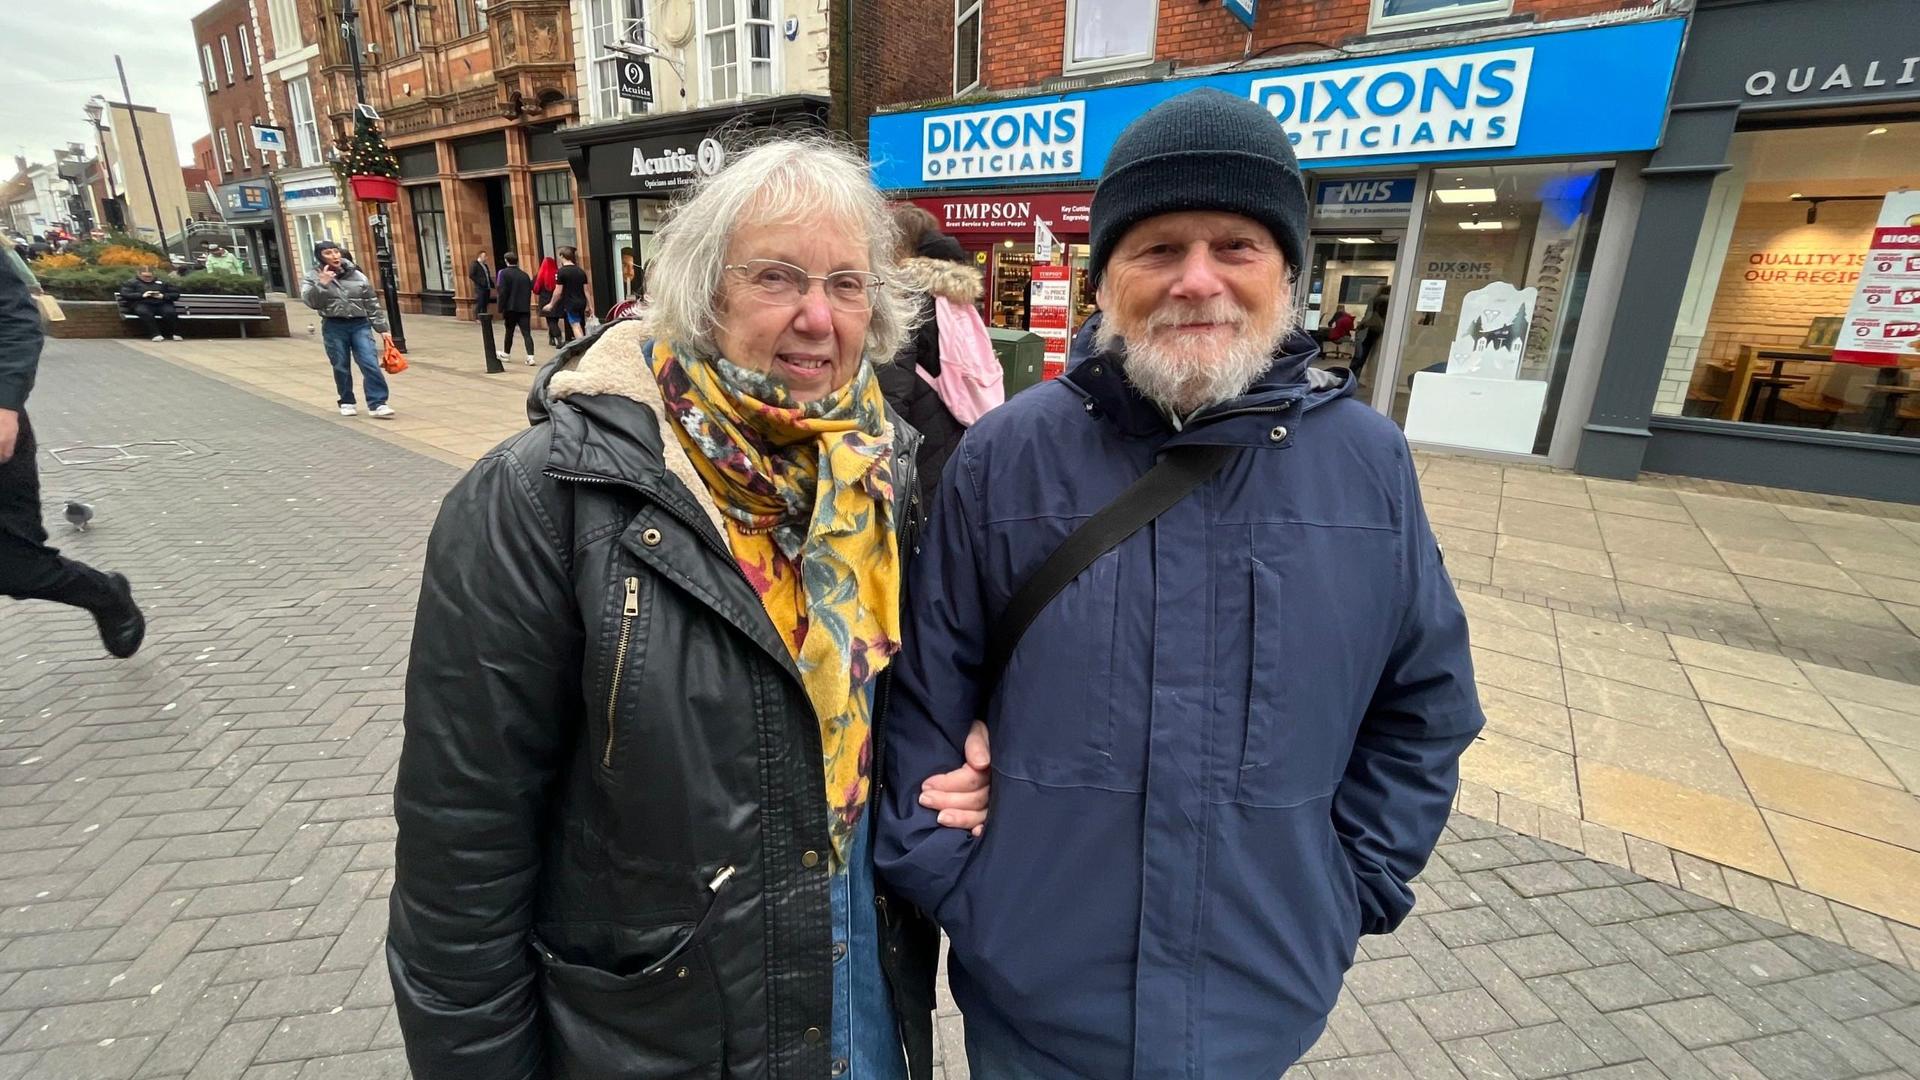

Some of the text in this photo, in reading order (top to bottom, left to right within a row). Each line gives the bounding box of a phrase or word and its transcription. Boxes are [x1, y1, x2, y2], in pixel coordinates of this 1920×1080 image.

[1745, 57, 1920, 96] QUALI
[622, 84, 651, 96] Acuitis
[1259, 59, 1516, 124] DIXONS
[928, 108, 1076, 154] DIXONS
[1287, 116, 1506, 151] PTICIANS
[630, 148, 697, 176] Acuitis
[928, 150, 1074, 176] OPTICIANS
[1339, 181, 1394, 201] NHS
[943, 202, 1031, 219] TIMPSON
[1428, 262, 1492, 272] DIXONS
[1750, 253, 1840, 266] QUALITY
[1744, 270, 1788, 282] OUR
[1795, 271, 1861, 283] RECIP
